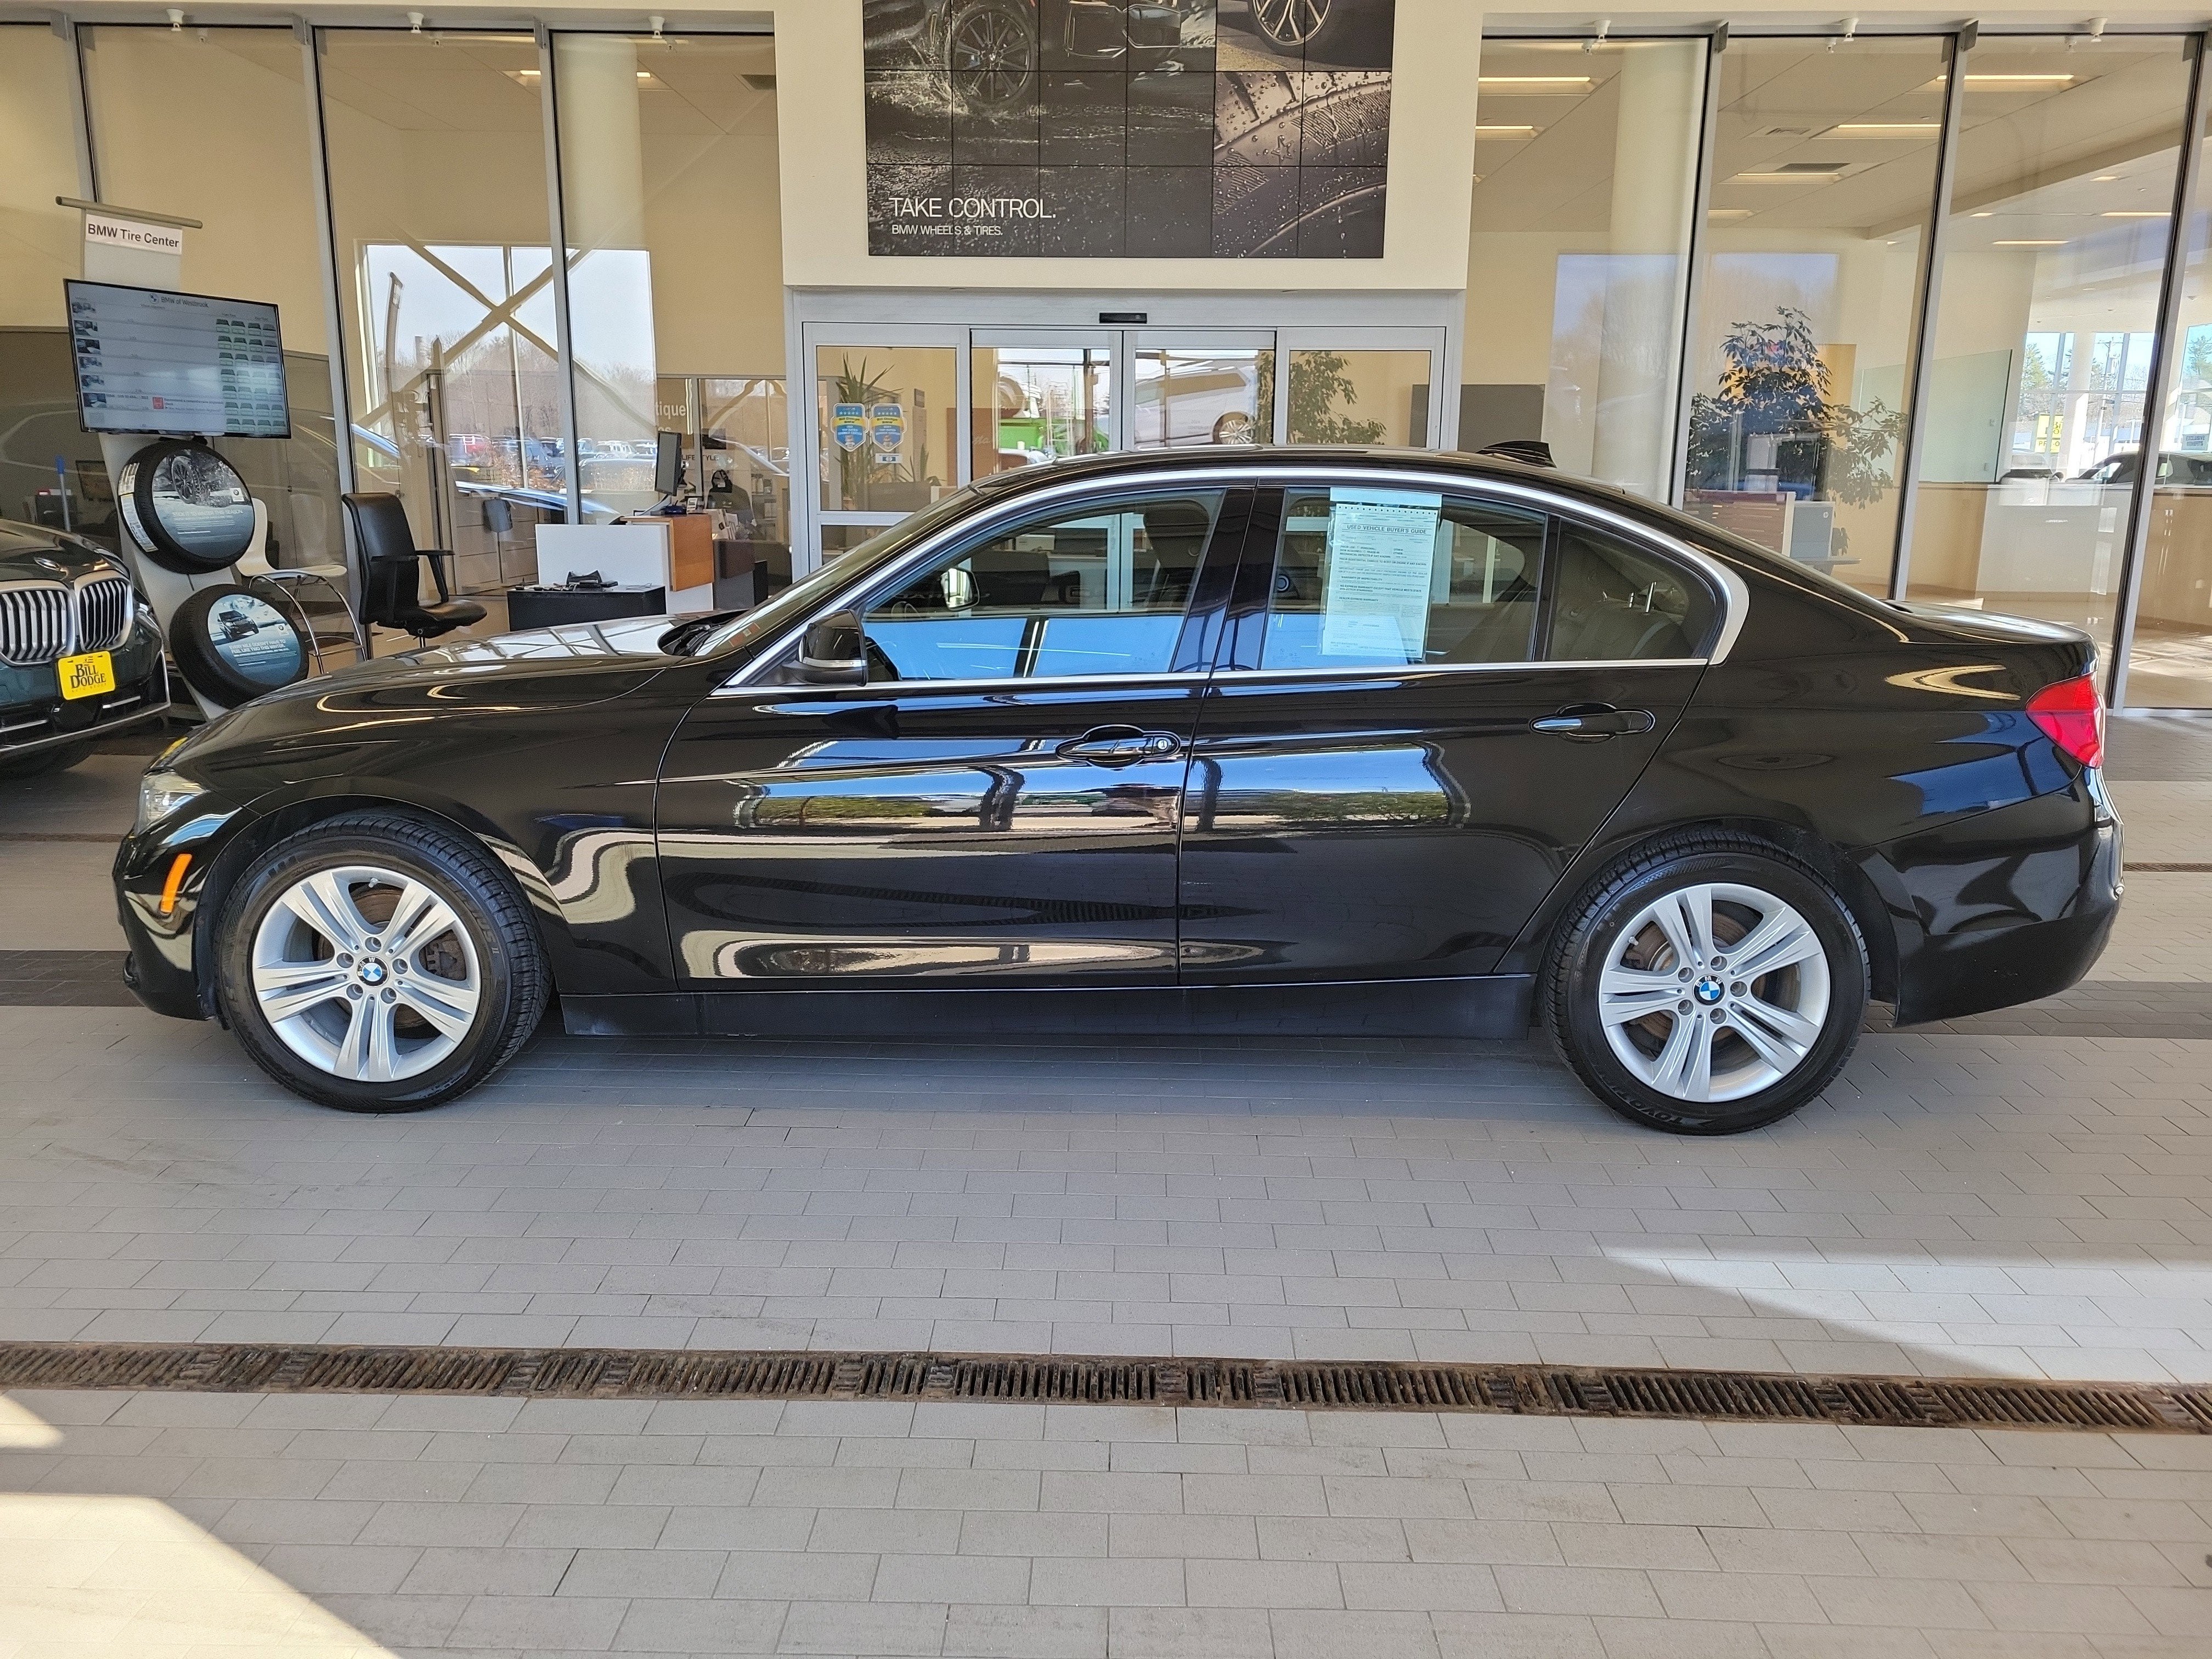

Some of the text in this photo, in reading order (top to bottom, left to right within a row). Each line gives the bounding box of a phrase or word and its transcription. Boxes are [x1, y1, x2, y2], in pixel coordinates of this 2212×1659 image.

[888, 198, 1056, 218] TAKE CONTROL.
[88, 223, 179, 247] BMW Tire Center
[891, 224, 1003, 235] BMW WHEELS & TIRES.
[182, 299, 209, 308] Westbrook
[357, 957, 375, 977] BMW
[1695, 975, 1723, 988] BMW
